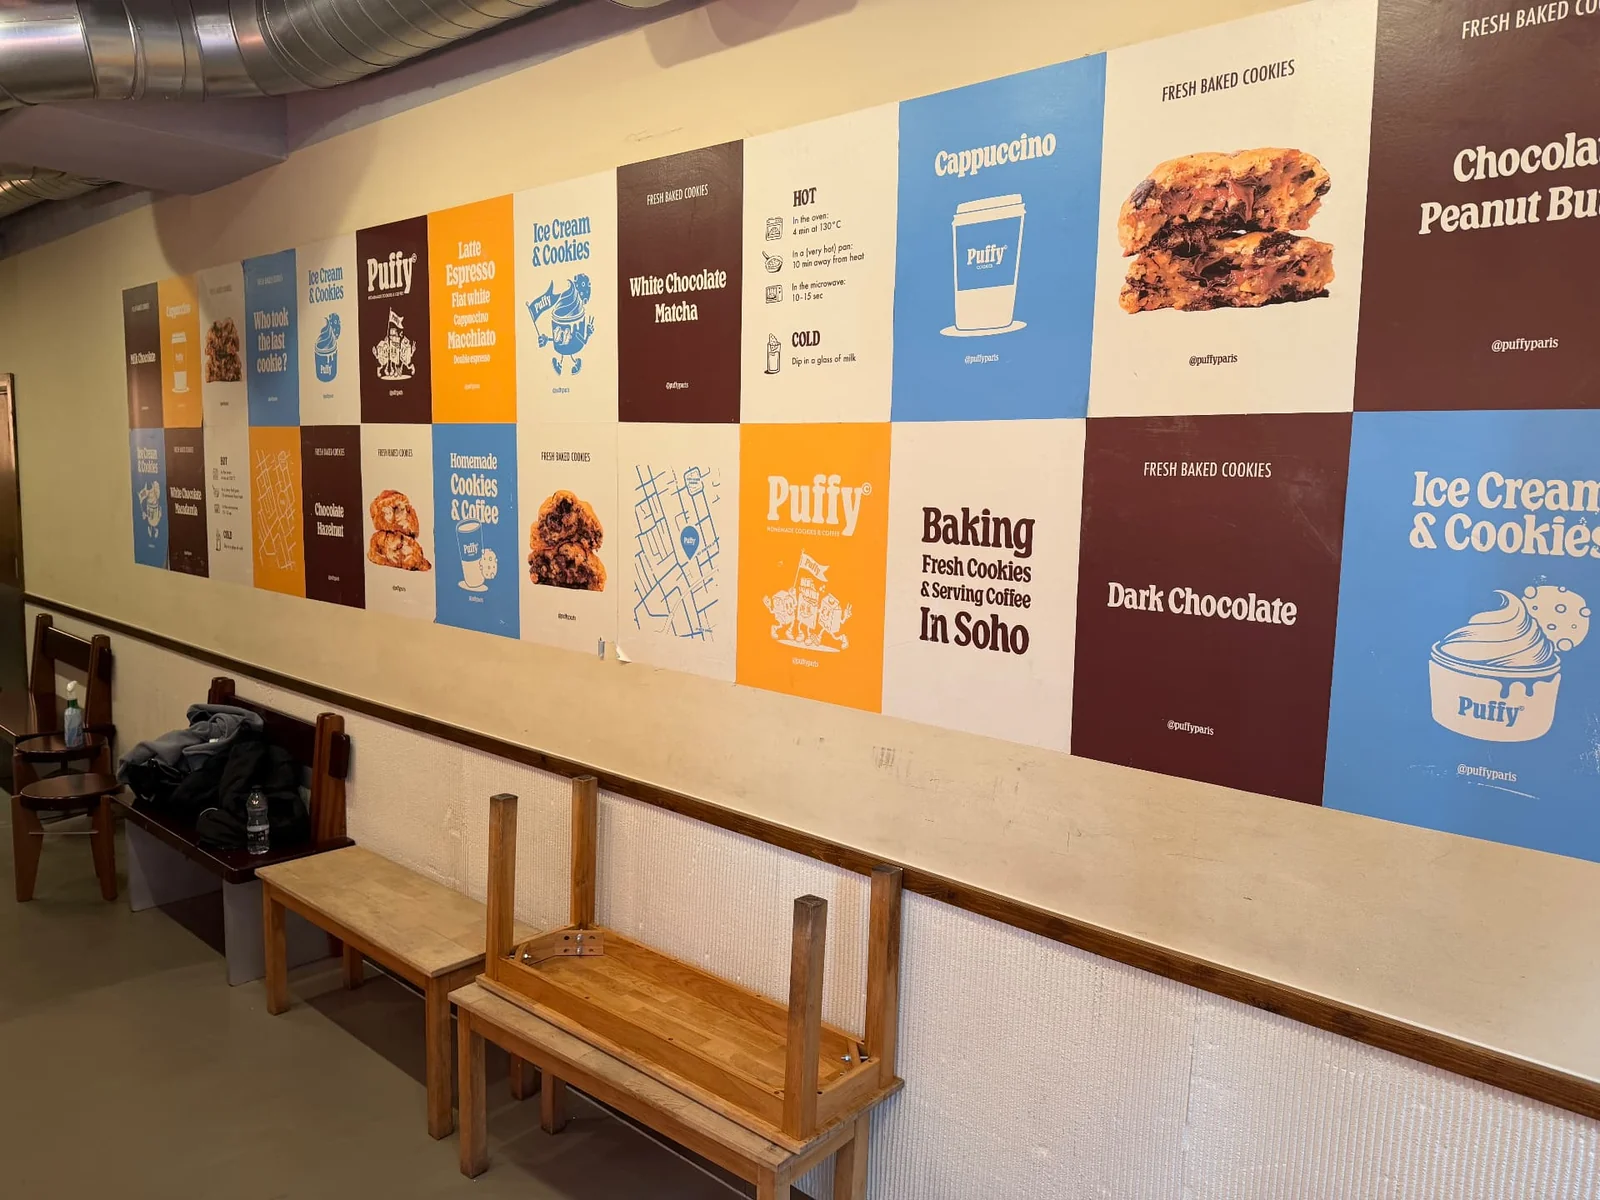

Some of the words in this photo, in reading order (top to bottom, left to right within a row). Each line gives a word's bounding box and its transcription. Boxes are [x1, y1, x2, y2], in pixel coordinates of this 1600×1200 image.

[1461, 12, 1510, 40] FRESH
[1515, 0, 1569, 29] BAKED
[1162, 80, 1197, 103] FRESH
[1200, 71, 1239, 95] BAKED
[1242, 59, 1295, 86] COOKIES
[934, 132, 1057, 178] Cappuccino
[1453, 132, 1600, 183] Chocola
[646, 193, 664, 206] FRESH
[665, 189, 683, 203] BAKED
[684, 183, 709, 199] COOKIES
[792, 187, 817, 207] HOT
[792, 216, 799, 225] In
[800, 214, 810, 223] the
[811, 213, 829, 222] oven:
[1418, 191, 1542, 235] Peanut
[533, 222, 550, 243] Ice
[552, 216, 591, 240] Cream
[792, 227, 797, 236] 4
[798, 226, 810, 235] min
[811, 225, 818, 233] at
[458, 239, 482, 260] Latte
[532, 246, 541, 267] &
[542, 239, 590, 266] Cookies
[792, 250, 798, 258] In
[823, 243, 836, 254] hot)
[838, 243, 853, 254] pan:
[793, 260, 800, 269] 10
[802, 260, 813, 268] min
[814, 259, 831, 267] away
[832, 255, 848, 264] from
[849, 252, 865, 262] heat
[308, 269, 319, 286] Ice
[320, 266, 344, 284] Cream
[445, 260, 496, 288] Espresso
[629, 275, 664, 298] White
[665, 268, 727, 295] Chocolate
[309, 286, 315, 304] &
[315, 283, 344, 303] Cookies
[792, 283, 797, 291] In
[799, 282, 809, 290] the
[810, 279, 846, 289] microwave:
[451, 291, 467, 308] Flat
[467, 288, 491, 306] white
[534, 295, 551, 314] Puffy
[813, 292, 823, 300] sec
[253, 310, 271, 330] Who
[271, 307, 289, 328] took
[453, 311, 488, 327] Cappuccino
[655, 300, 698, 323] Matcha
[258, 332, 271, 351] the
[271, 331, 285, 350] last
[447, 328, 496, 349] Macchiato
[792, 330, 820, 347] COLD
[1491, 337, 1559, 353] @puffyparis
[453, 354, 470, 364] Double
[470, 354, 490, 365] espresso
[792, 357, 802, 367] Dip
[817, 355, 832, 366] glass
[834, 354, 841, 363] of
[843, 353, 856, 362] milk
[964, 354, 999, 364] @puffyparis
[1188, 353, 1238, 366] @puffyparis
[450, 452, 498, 470] Homemade
[541, 451, 555, 462] FRESH
[555, 451, 570, 462] BAKED
[571, 452, 591, 463] COOKIES
[1143, 461, 1177, 477] FRESH
[1181, 461, 1218, 478] BAKED
[1221, 462, 1272, 479] COOKIES
[170, 486, 182, 499] White
[182, 487, 202, 500] Chocolate
[450, 472, 498, 498] Cookies
[1411, 471, 1470, 508] Ice
[314, 502, 345, 518] Chocolate
[451, 499, 460, 521] &
[461, 499, 499, 525] Coffee
[317, 521, 344, 538] Hazelnut
[766, 526, 794, 534] HOMEMADE
[920, 506, 1035, 558] Baking
[1408, 512, 1437, 550] &
[683, 536, 696, 546] Puffy
[804, 558, 821, 576] Puffy
[921, 554, 964, 577] Fresh
[967, 557, 1032, 583] Cookies
[920, 582, 930, 598] &
[931, 582, 984, 607] Serving
[985, 587, 1031, 609] Coffee
[1107, 581, 1164, 613] Dark
[1167, 586, 1298, 627] Chocolate
[919, 606, 949, 644] In
[953, 611, 1029, 655] Soho
[1166, 718, 1214, 737] @puffyparis
[1457, 763, 1517, 782] @puffyparis
